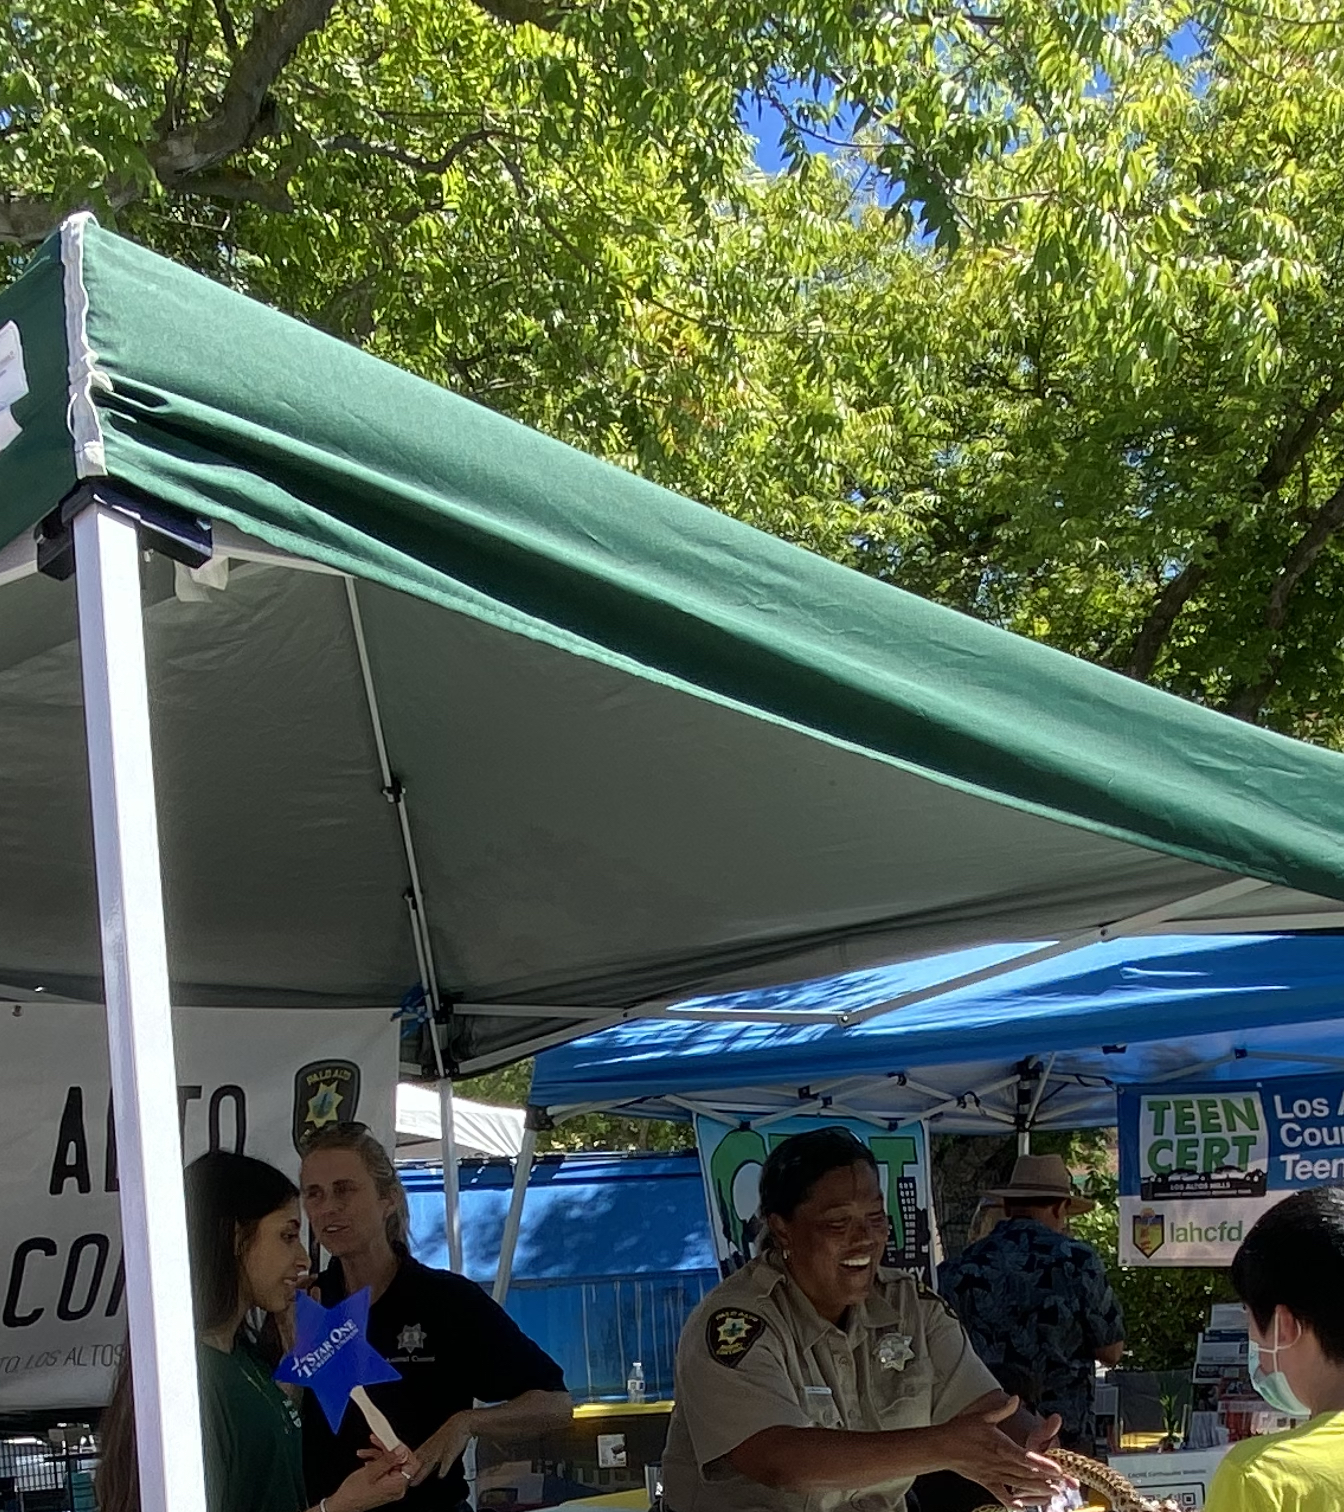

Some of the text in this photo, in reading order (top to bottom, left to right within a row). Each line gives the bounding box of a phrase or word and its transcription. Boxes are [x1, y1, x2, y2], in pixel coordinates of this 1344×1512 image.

[1147, 1097, 1260, 1136] TEEN
[1274, 1094, 1329, 1120] Los
[1147, 1135, 1258, 1175] CERT
[1170, 1183, 1184, 1191] LOS
[1169, 1220, 1242, 1244] lahcfd
[26, 1349, 57, 1370] LOS
